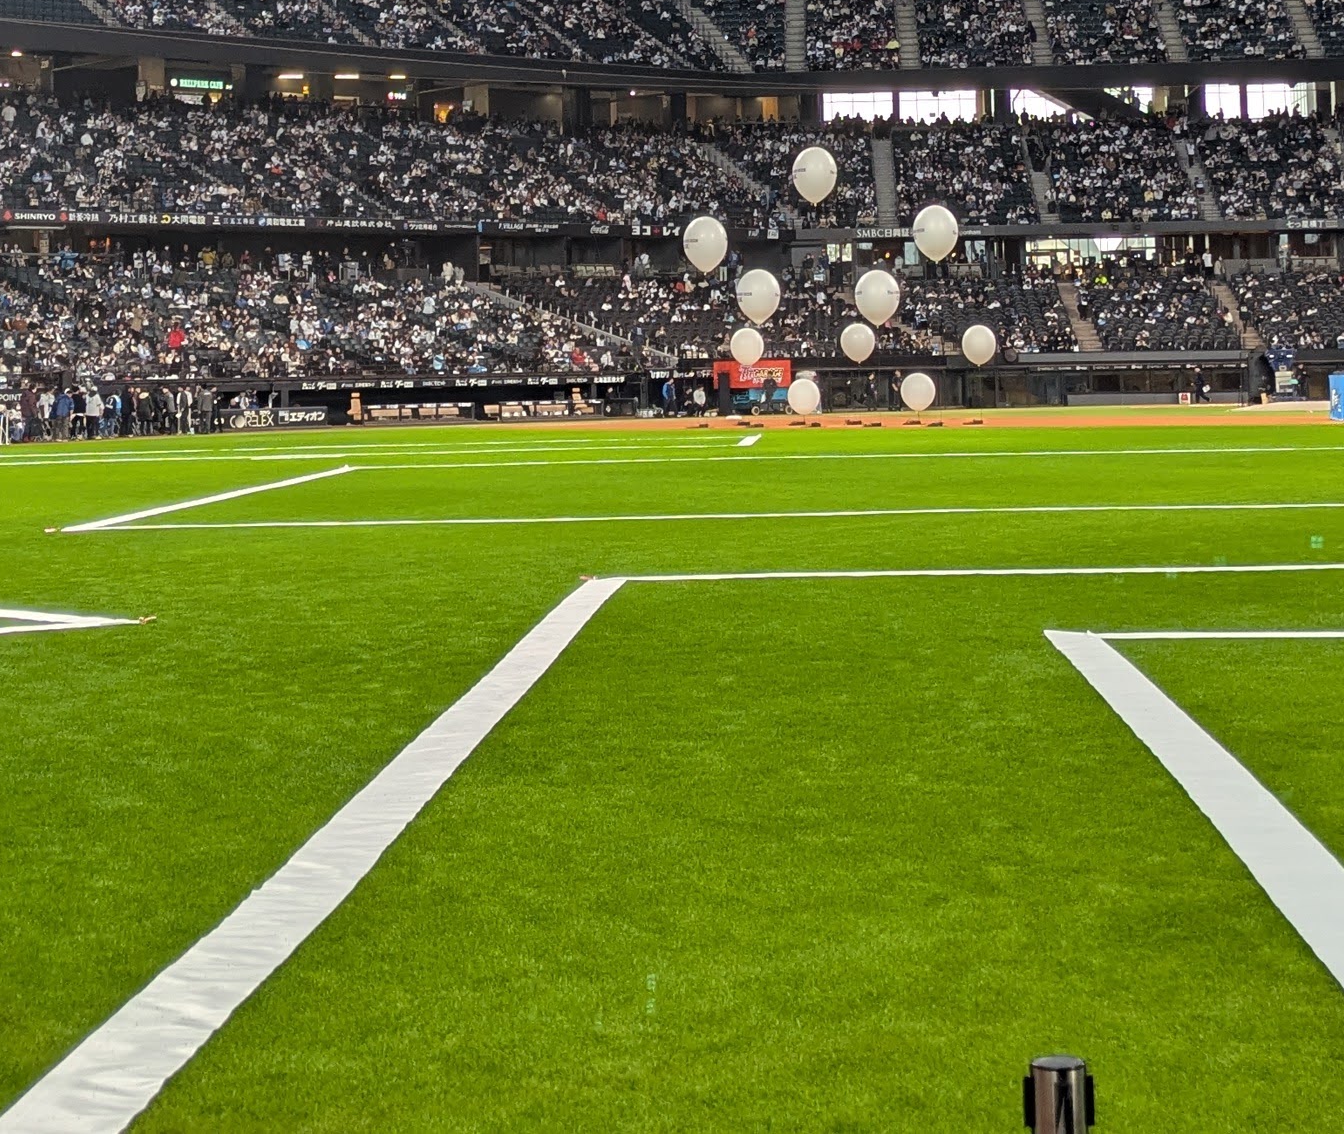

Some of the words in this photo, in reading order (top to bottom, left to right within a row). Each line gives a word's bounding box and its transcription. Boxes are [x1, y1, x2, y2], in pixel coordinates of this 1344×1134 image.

[14, 212, 56, 221] SHINRYO
[108, 213, 158, 224] 乃村工藝社
[857, 228, 910, 238] SMBC日興証
[289, 411, 326, 422] エディオン
